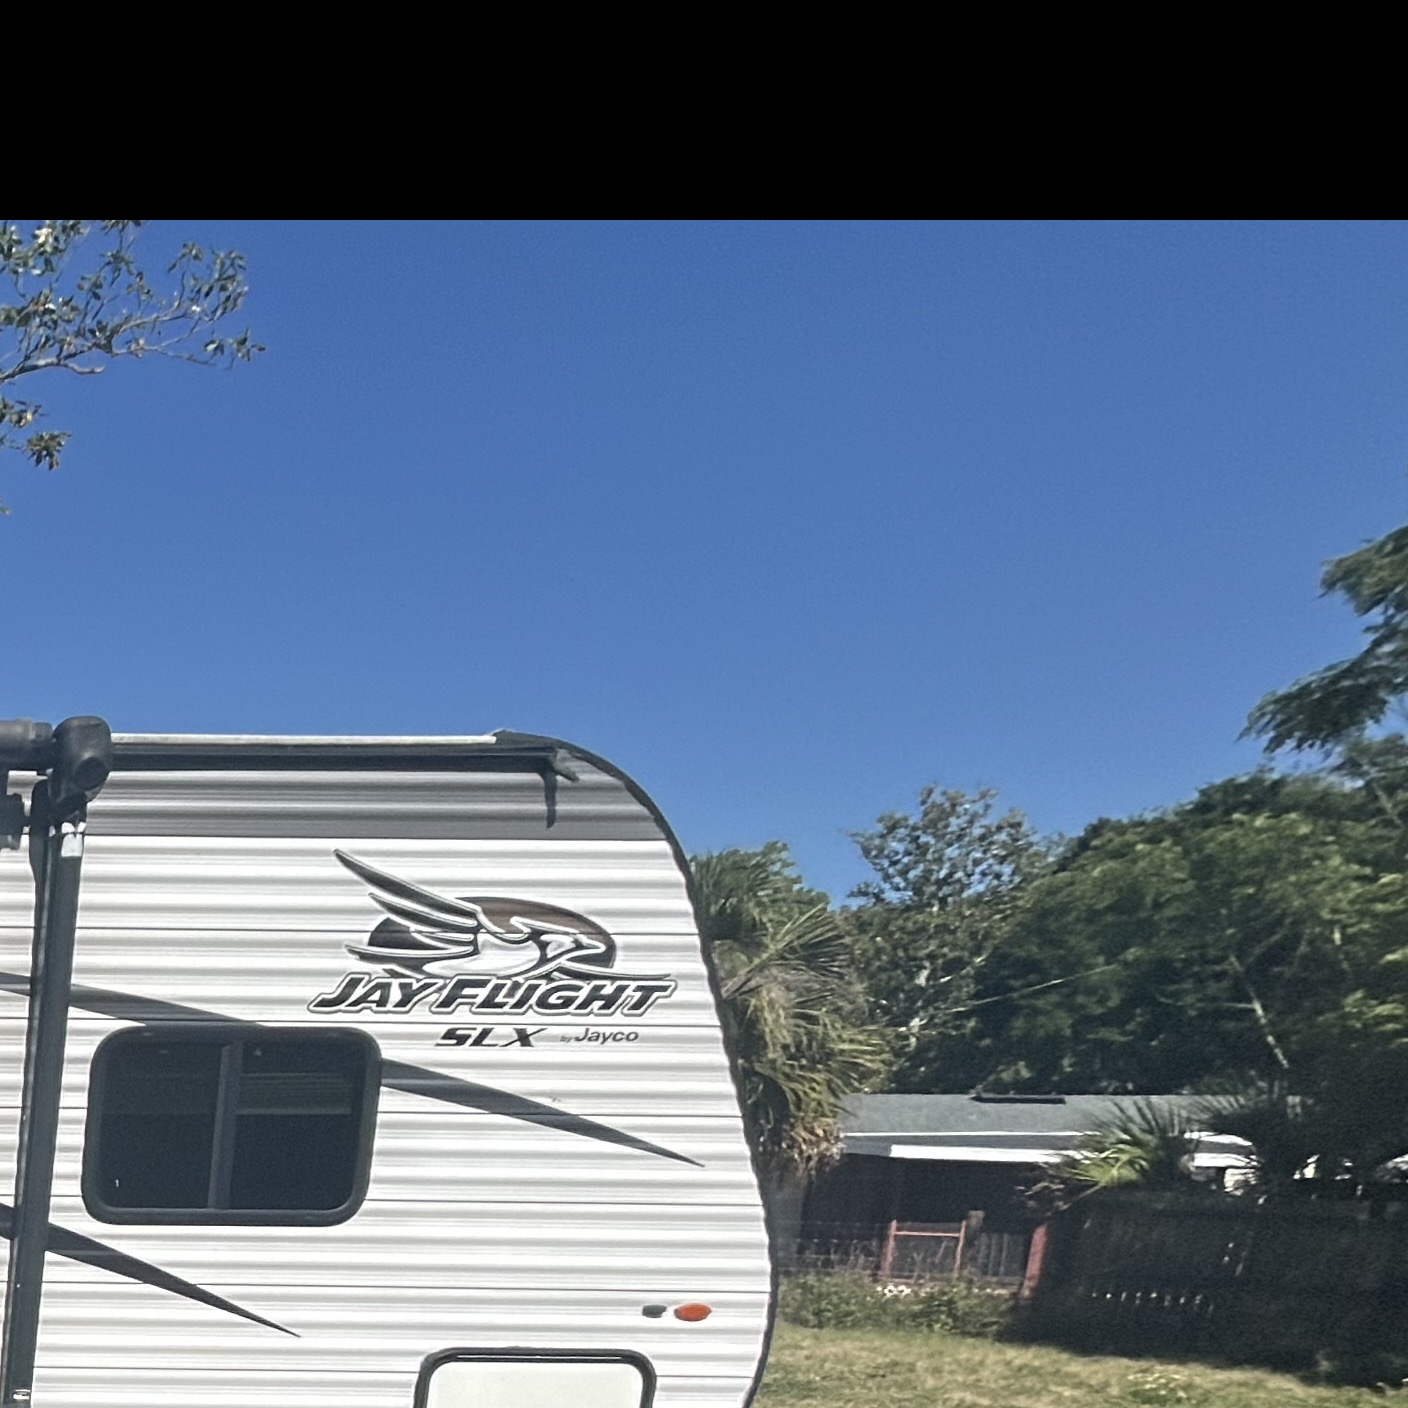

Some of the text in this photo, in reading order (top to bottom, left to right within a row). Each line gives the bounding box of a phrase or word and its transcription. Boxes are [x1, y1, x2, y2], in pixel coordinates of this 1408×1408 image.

[309, 973, 677, 1016] JAY FLIGHT
[434, 1027, 548, 1048] SLX
[574, 1027, 640, 1045] Jayco
